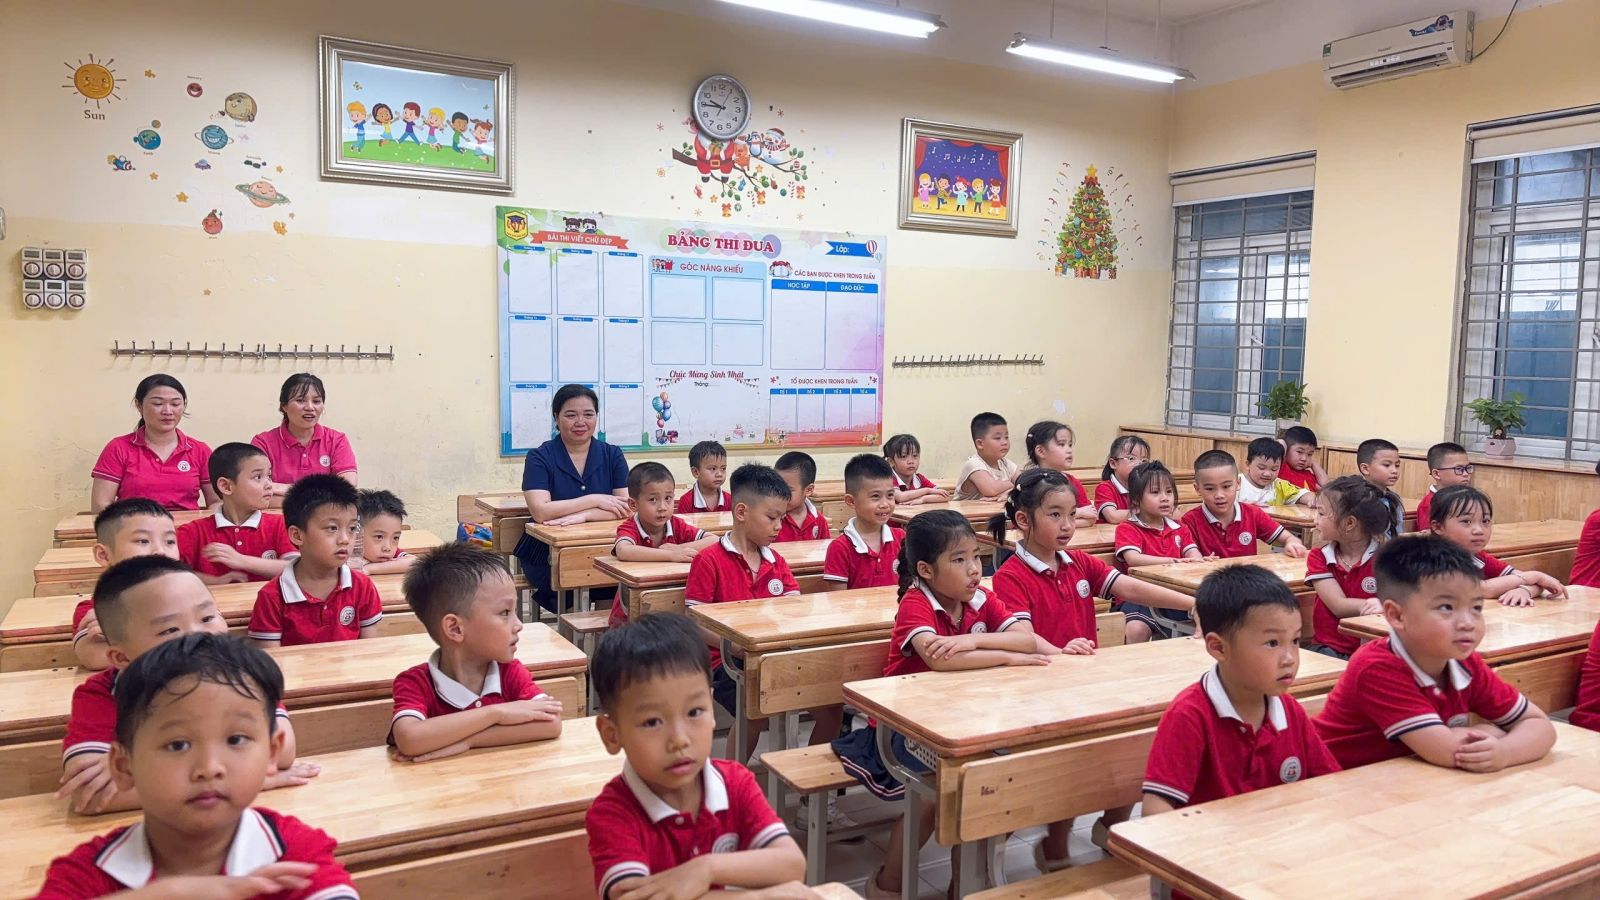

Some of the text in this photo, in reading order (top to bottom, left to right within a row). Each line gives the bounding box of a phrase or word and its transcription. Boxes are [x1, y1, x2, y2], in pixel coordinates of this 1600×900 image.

[84, 109, 106, 120] Sun
[667, 231, 774, 252] BẢNG THI ĐUA
[680, 261, 698, 271] GÓC
[723, 263, 744, 273] KHIẾU
[794, 269, 806, 277] CÁC
[669, 369, 686, 378] Chúc
[709, 370, 726, 378] Sinh
